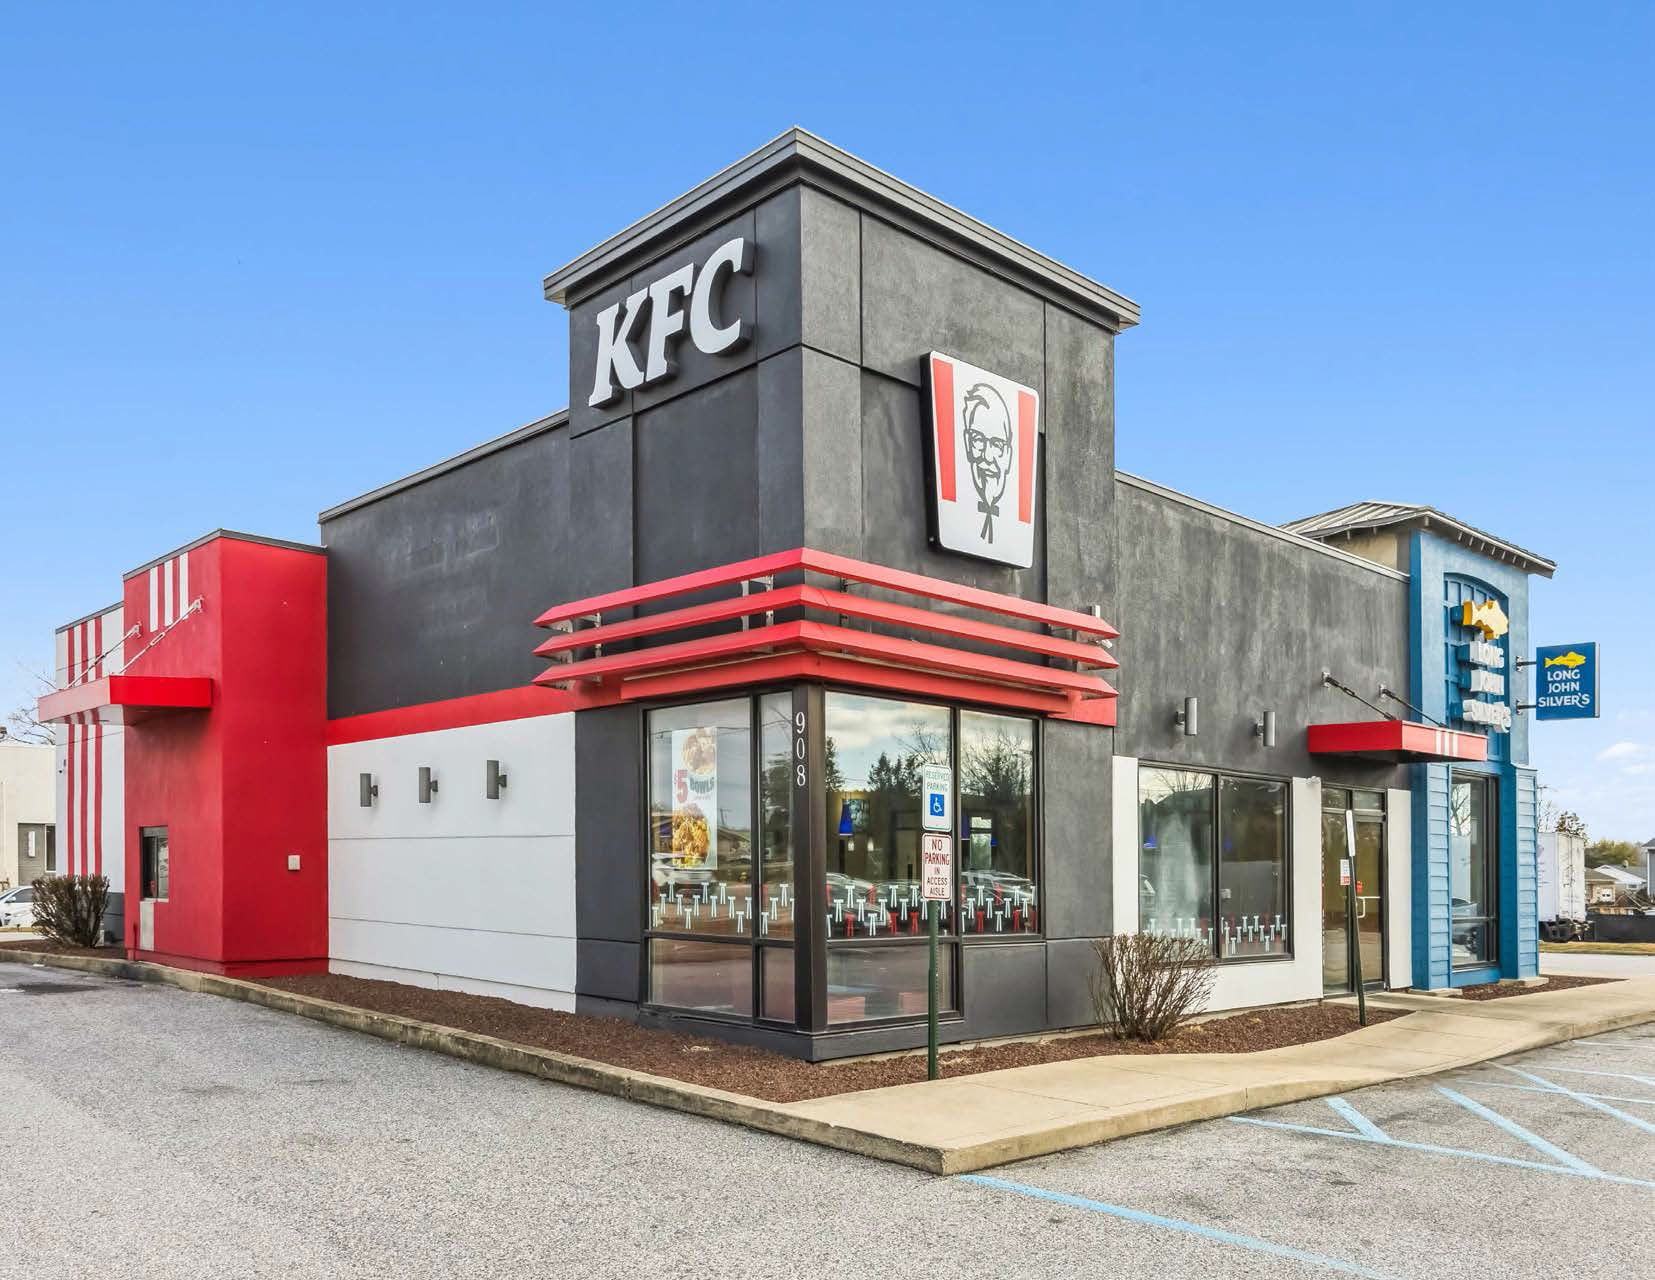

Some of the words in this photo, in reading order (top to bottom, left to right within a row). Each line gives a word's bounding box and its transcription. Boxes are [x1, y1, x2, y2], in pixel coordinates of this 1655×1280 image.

[588, 237, 744, 407] KFC
[1547, 669, 1580, 681] LONG
[1548, 681, 1580, 694] JOHN
[1538, 692, 1590, 708] SILVER'S
[795, 711, 806, 787] 908
[926, 781, 948, 793] PARKING
[931, 839, 943, 851] NO
[924, 852, 950, 866] PARKING
[926, 877, 948, 886] ACCESS
[929, 887, 945, 897] AISLE
